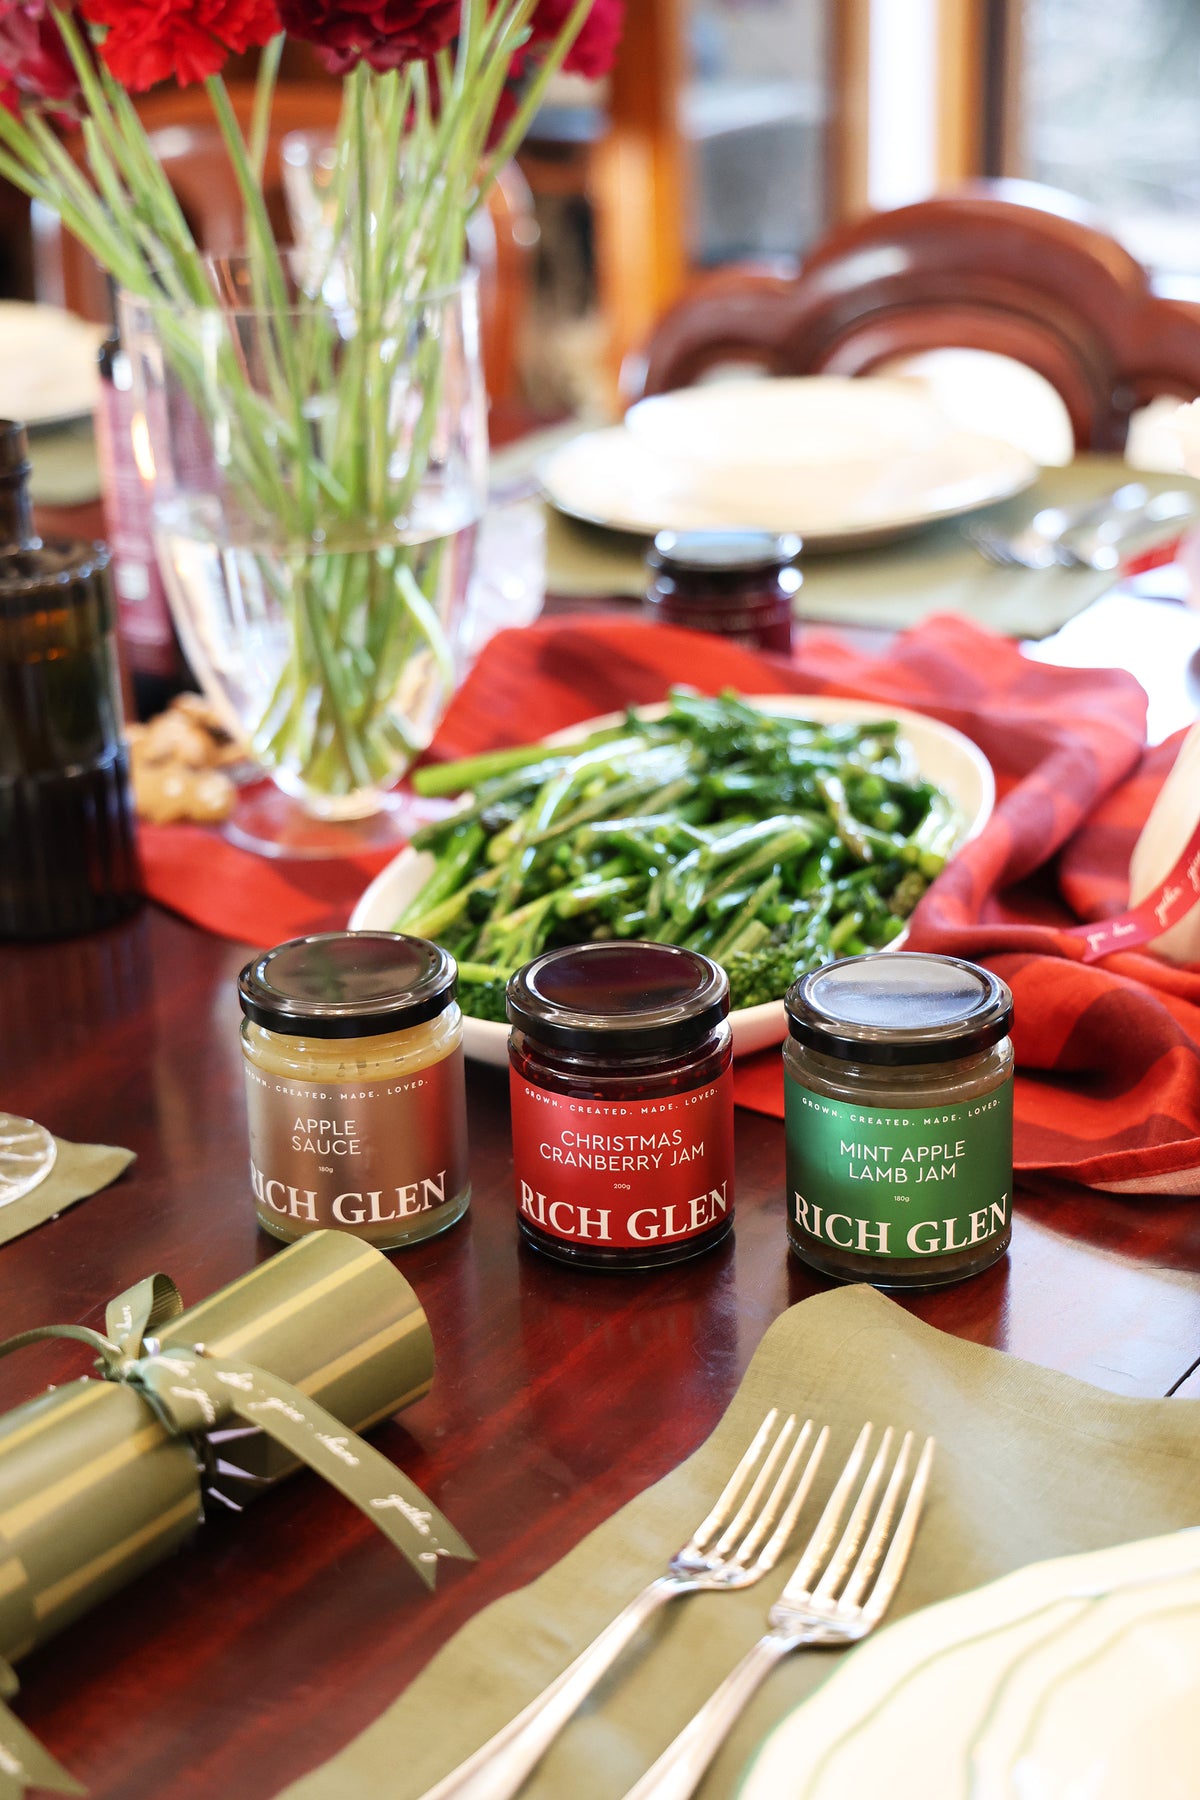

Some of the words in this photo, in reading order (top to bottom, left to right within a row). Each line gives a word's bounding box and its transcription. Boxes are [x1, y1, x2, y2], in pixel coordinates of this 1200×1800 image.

[276, 1085, 332, 1100] CREATED.
[340, 1091, 380, 1100] MADE.
[387, 1079, 429, 1096] LOVED.
[525, 1087, 563, 1109] GROWN.
[569, 1104, 633, 1116] CREATED.
[641, 1103, 678, 1114] MADE.
[685, 1087, 718, 1106] LOVED.
[802, 1097, 843, 1119] GROWN.
[850, 1114, 915, 1126] CREATED.
[924, 1114, 962, 1125] MADE.
[968, 1099, 1001, 1117] LOVED.
[294, 1117, 357, 1136] APPLE
[291, 1135, 361, 1155] SAUCE
[561, 1129, 682, 1152] CHRISTMAS
[840, 1140, 893, 1162] MINT
[900, 1140, 966, 1163] APPLE
[540, 1143, 663, 1172] CRANBERRY
[670, 1142, 704, 1167] JAM
[849, 1163, 908, 1183] LAMB
[915, 1163, 957, 1183] JAM
[332, 1170, 447, 1225] GLEN
[613, 1183, 631, 1191] 200g
[520, 1179, 612, 1240] RICH
[626, 1180, 728, 1241] GLEN
[893, 1195, 910, 1203] 180g
[794, 1191, 892, 1254] RICH
[906, 1193, 1008, 1254] GLEN
